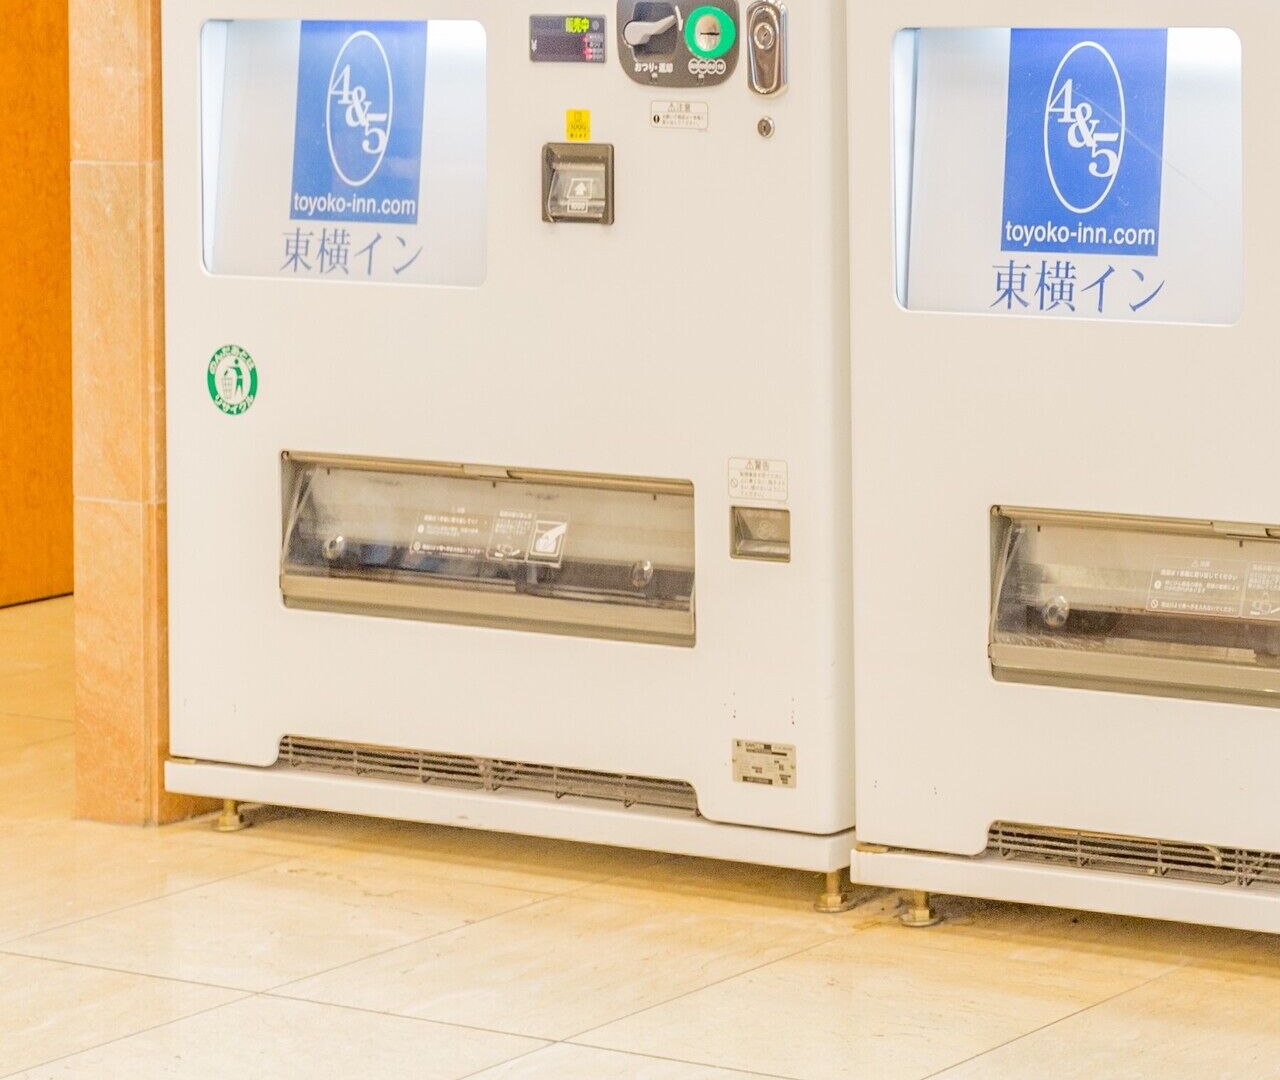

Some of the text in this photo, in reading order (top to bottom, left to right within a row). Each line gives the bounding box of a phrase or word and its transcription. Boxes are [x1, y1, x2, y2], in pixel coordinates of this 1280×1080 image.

[293, 191, 417, 220] toyoko-inn.com
[279, 227, 424, 277] 東横イン
[1005, 219, 1155, 251] toyoko-inn.com
[989, 259, 1166, 313] 東横イン
